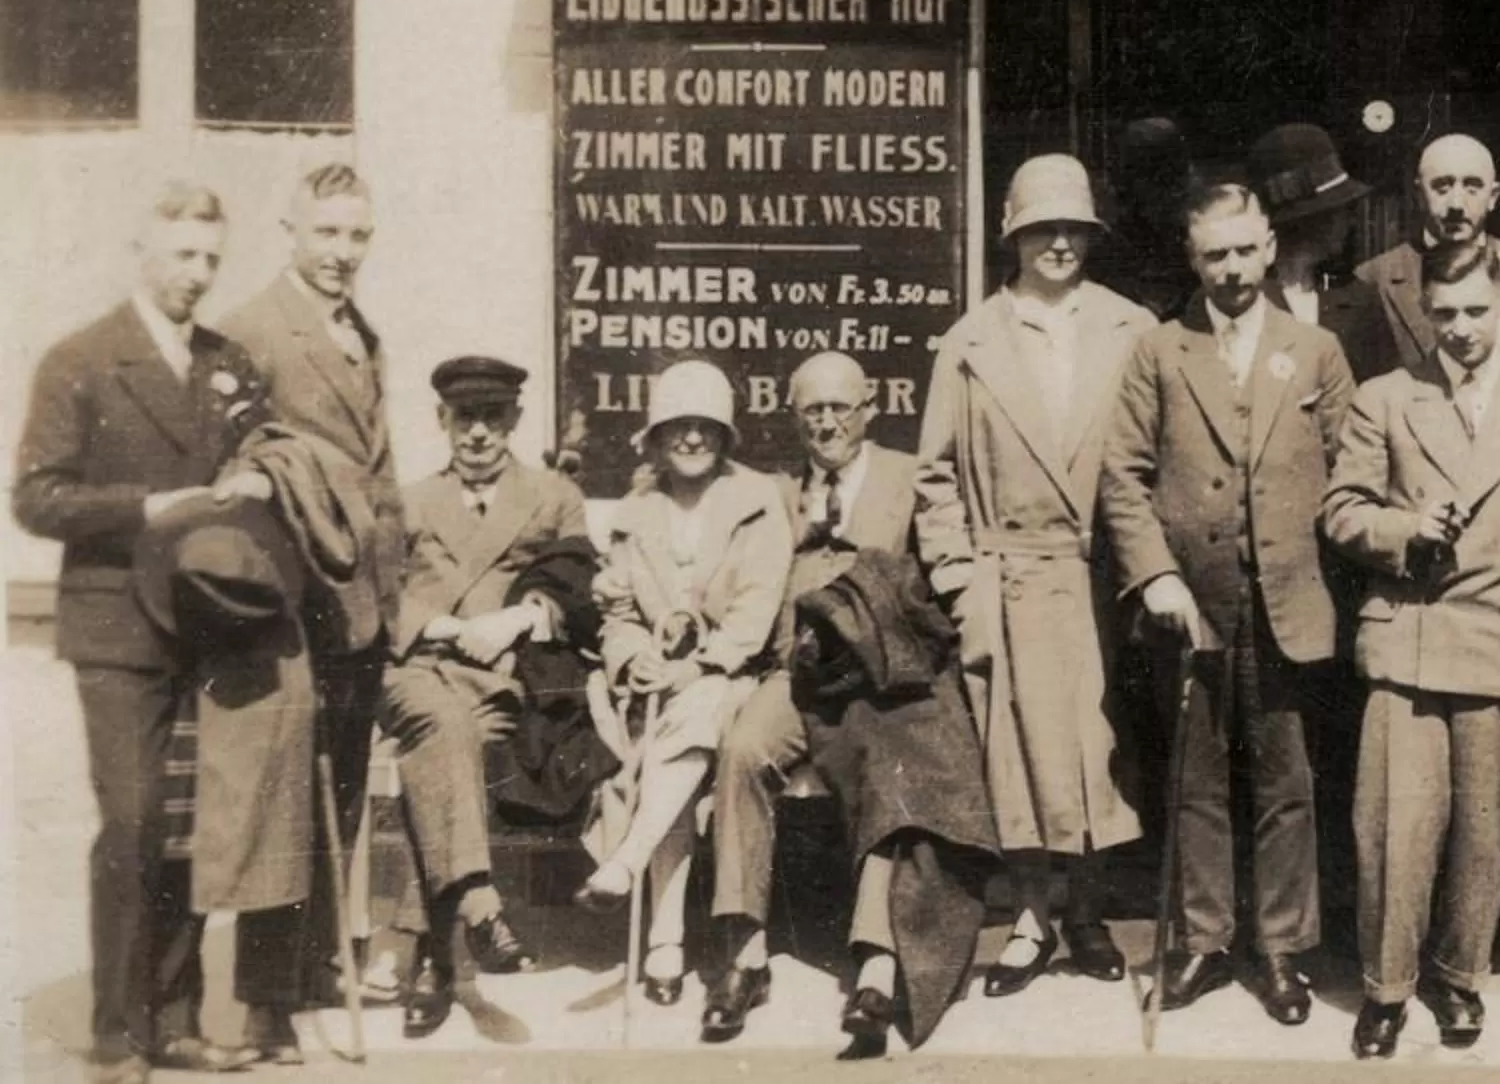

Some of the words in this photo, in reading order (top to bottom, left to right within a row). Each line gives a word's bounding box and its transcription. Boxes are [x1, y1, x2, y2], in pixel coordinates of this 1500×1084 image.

[571, 69, 665, 107] ALLER
[675, 69, 810, 107] CONFORT
[824, 68, 945, 108] MODERN
[571, 131, 706, 171] ZIMMER
[727, 132, 787, 171] MIT
[811, 133, 958, 173] FLIESS.
[820, 195, 942, 231] WASSER
[571, 256, 757, 304] ZIMMER
[770, 284, 827, 306] VON
[569, 310, 766, 350] PENSION
[774, 328, 830, 352] VON
